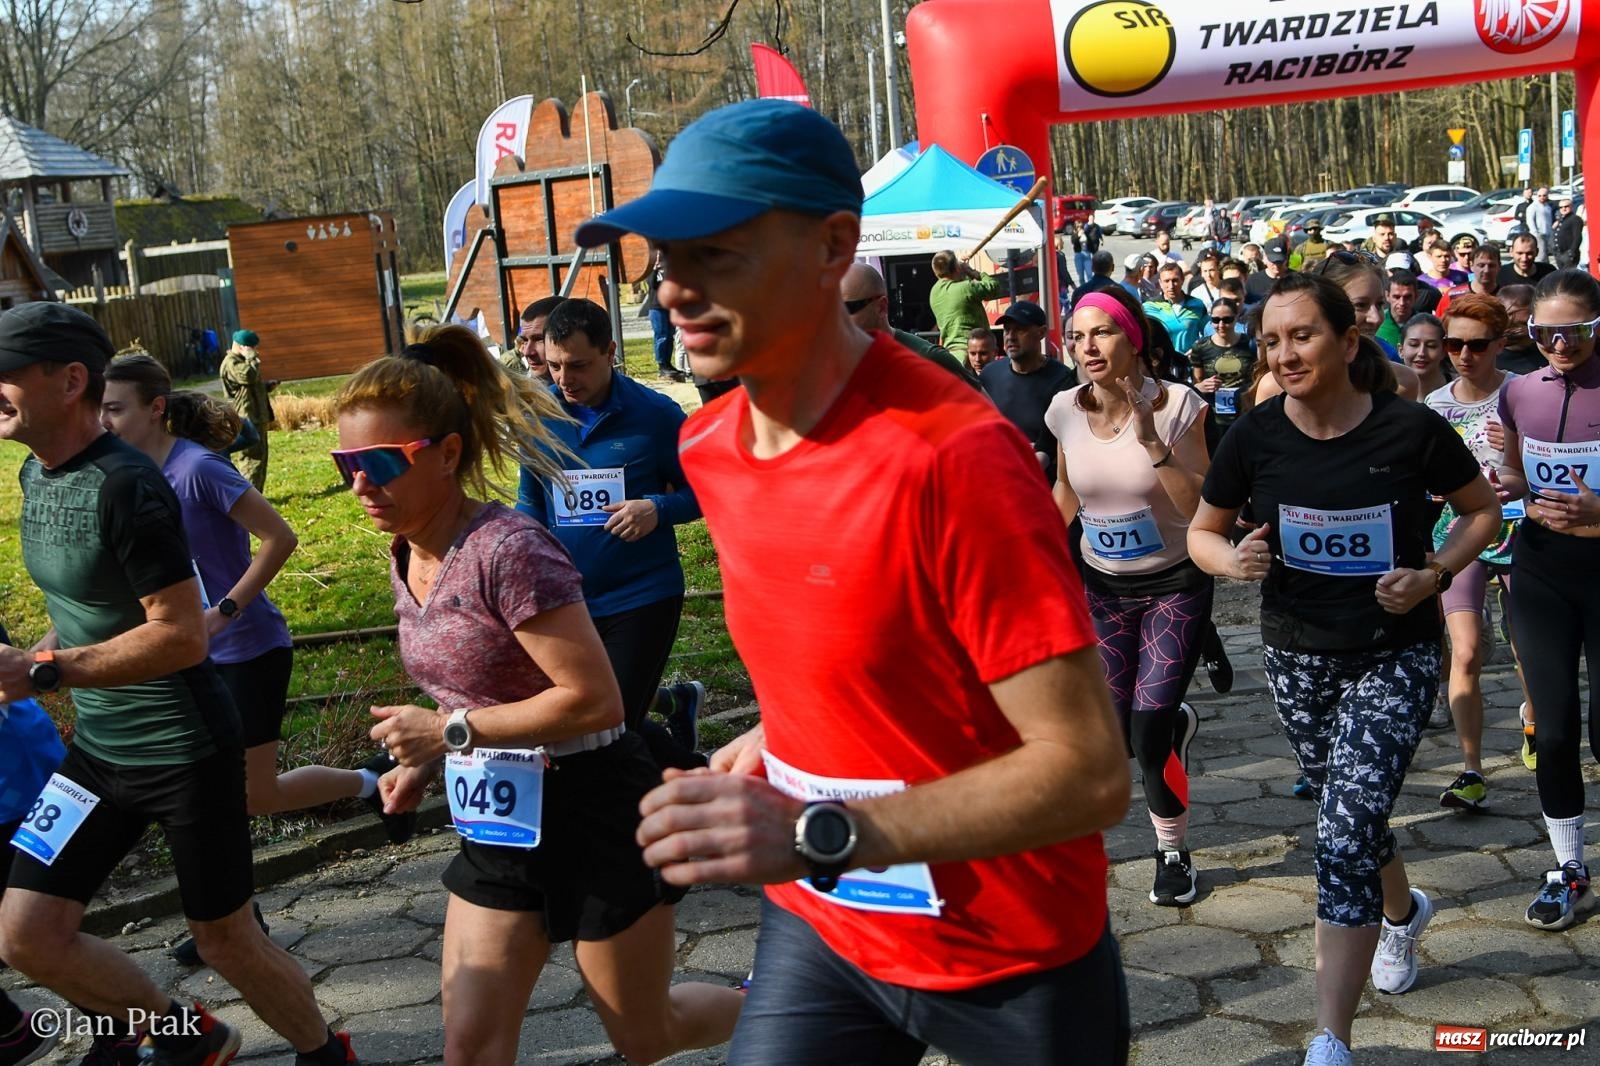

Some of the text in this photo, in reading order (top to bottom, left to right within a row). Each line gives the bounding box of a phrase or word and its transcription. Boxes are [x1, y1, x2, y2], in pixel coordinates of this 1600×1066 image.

[1200, 2, 1439, 49] TWARDZIELA
[1224, 44, 1415, 85] RACIBÓRZ
[1536, 462, 1588, 485] 027
[564, 489, 610, 511] 089
[1303, 512, 1324, 521] BIEG
[1098, 529, 1142, 548] 071
[1299, 532, 1371, 557] 068
[455, 776, 517, 817] 049
